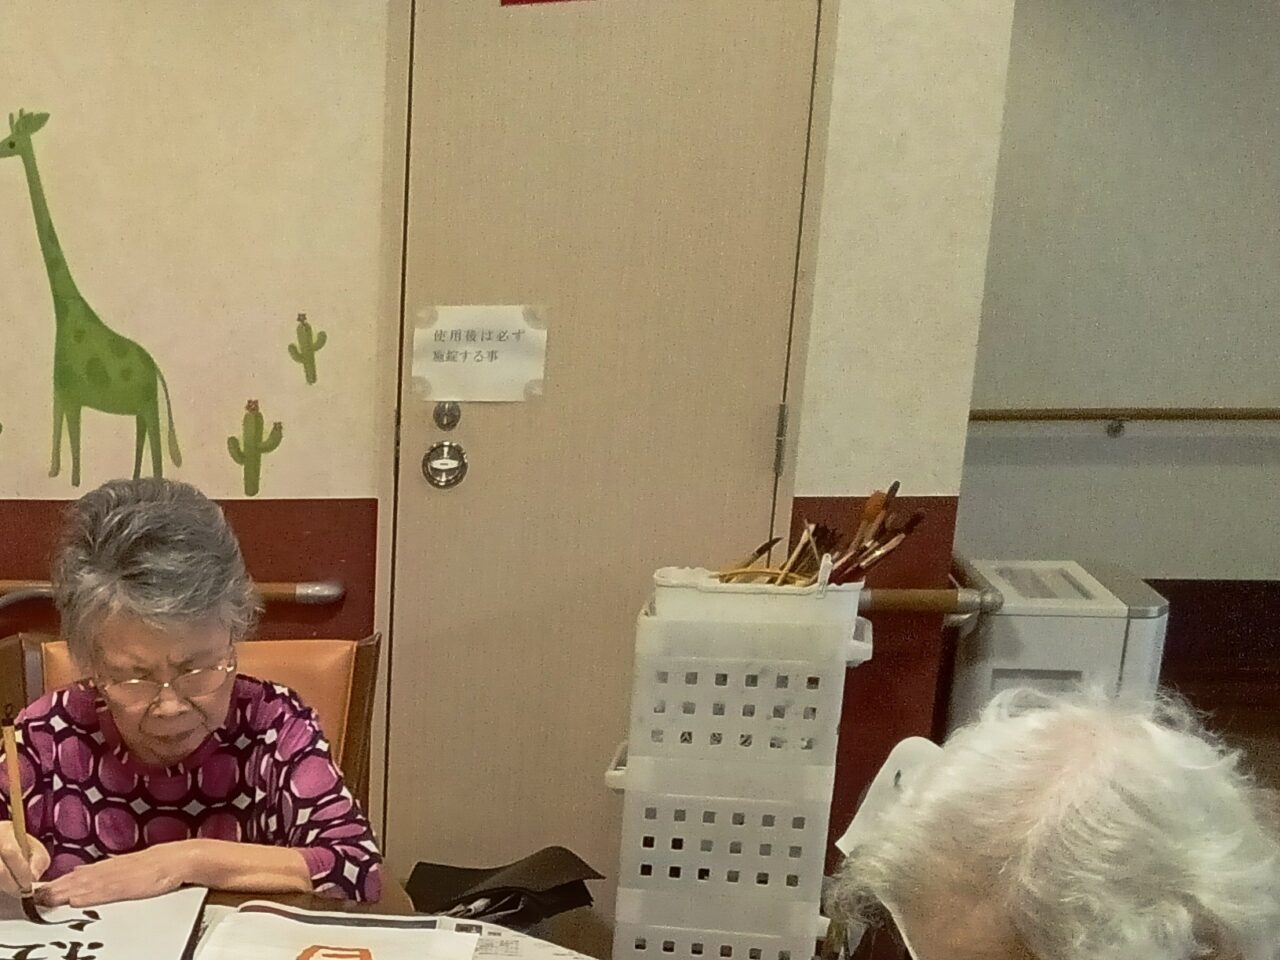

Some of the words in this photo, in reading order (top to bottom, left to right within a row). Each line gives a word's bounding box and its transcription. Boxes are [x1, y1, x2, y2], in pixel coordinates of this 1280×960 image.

[432, 328, 526, 344] 使用後は必ず
[431, 348, 499, 364] 施錠する事
